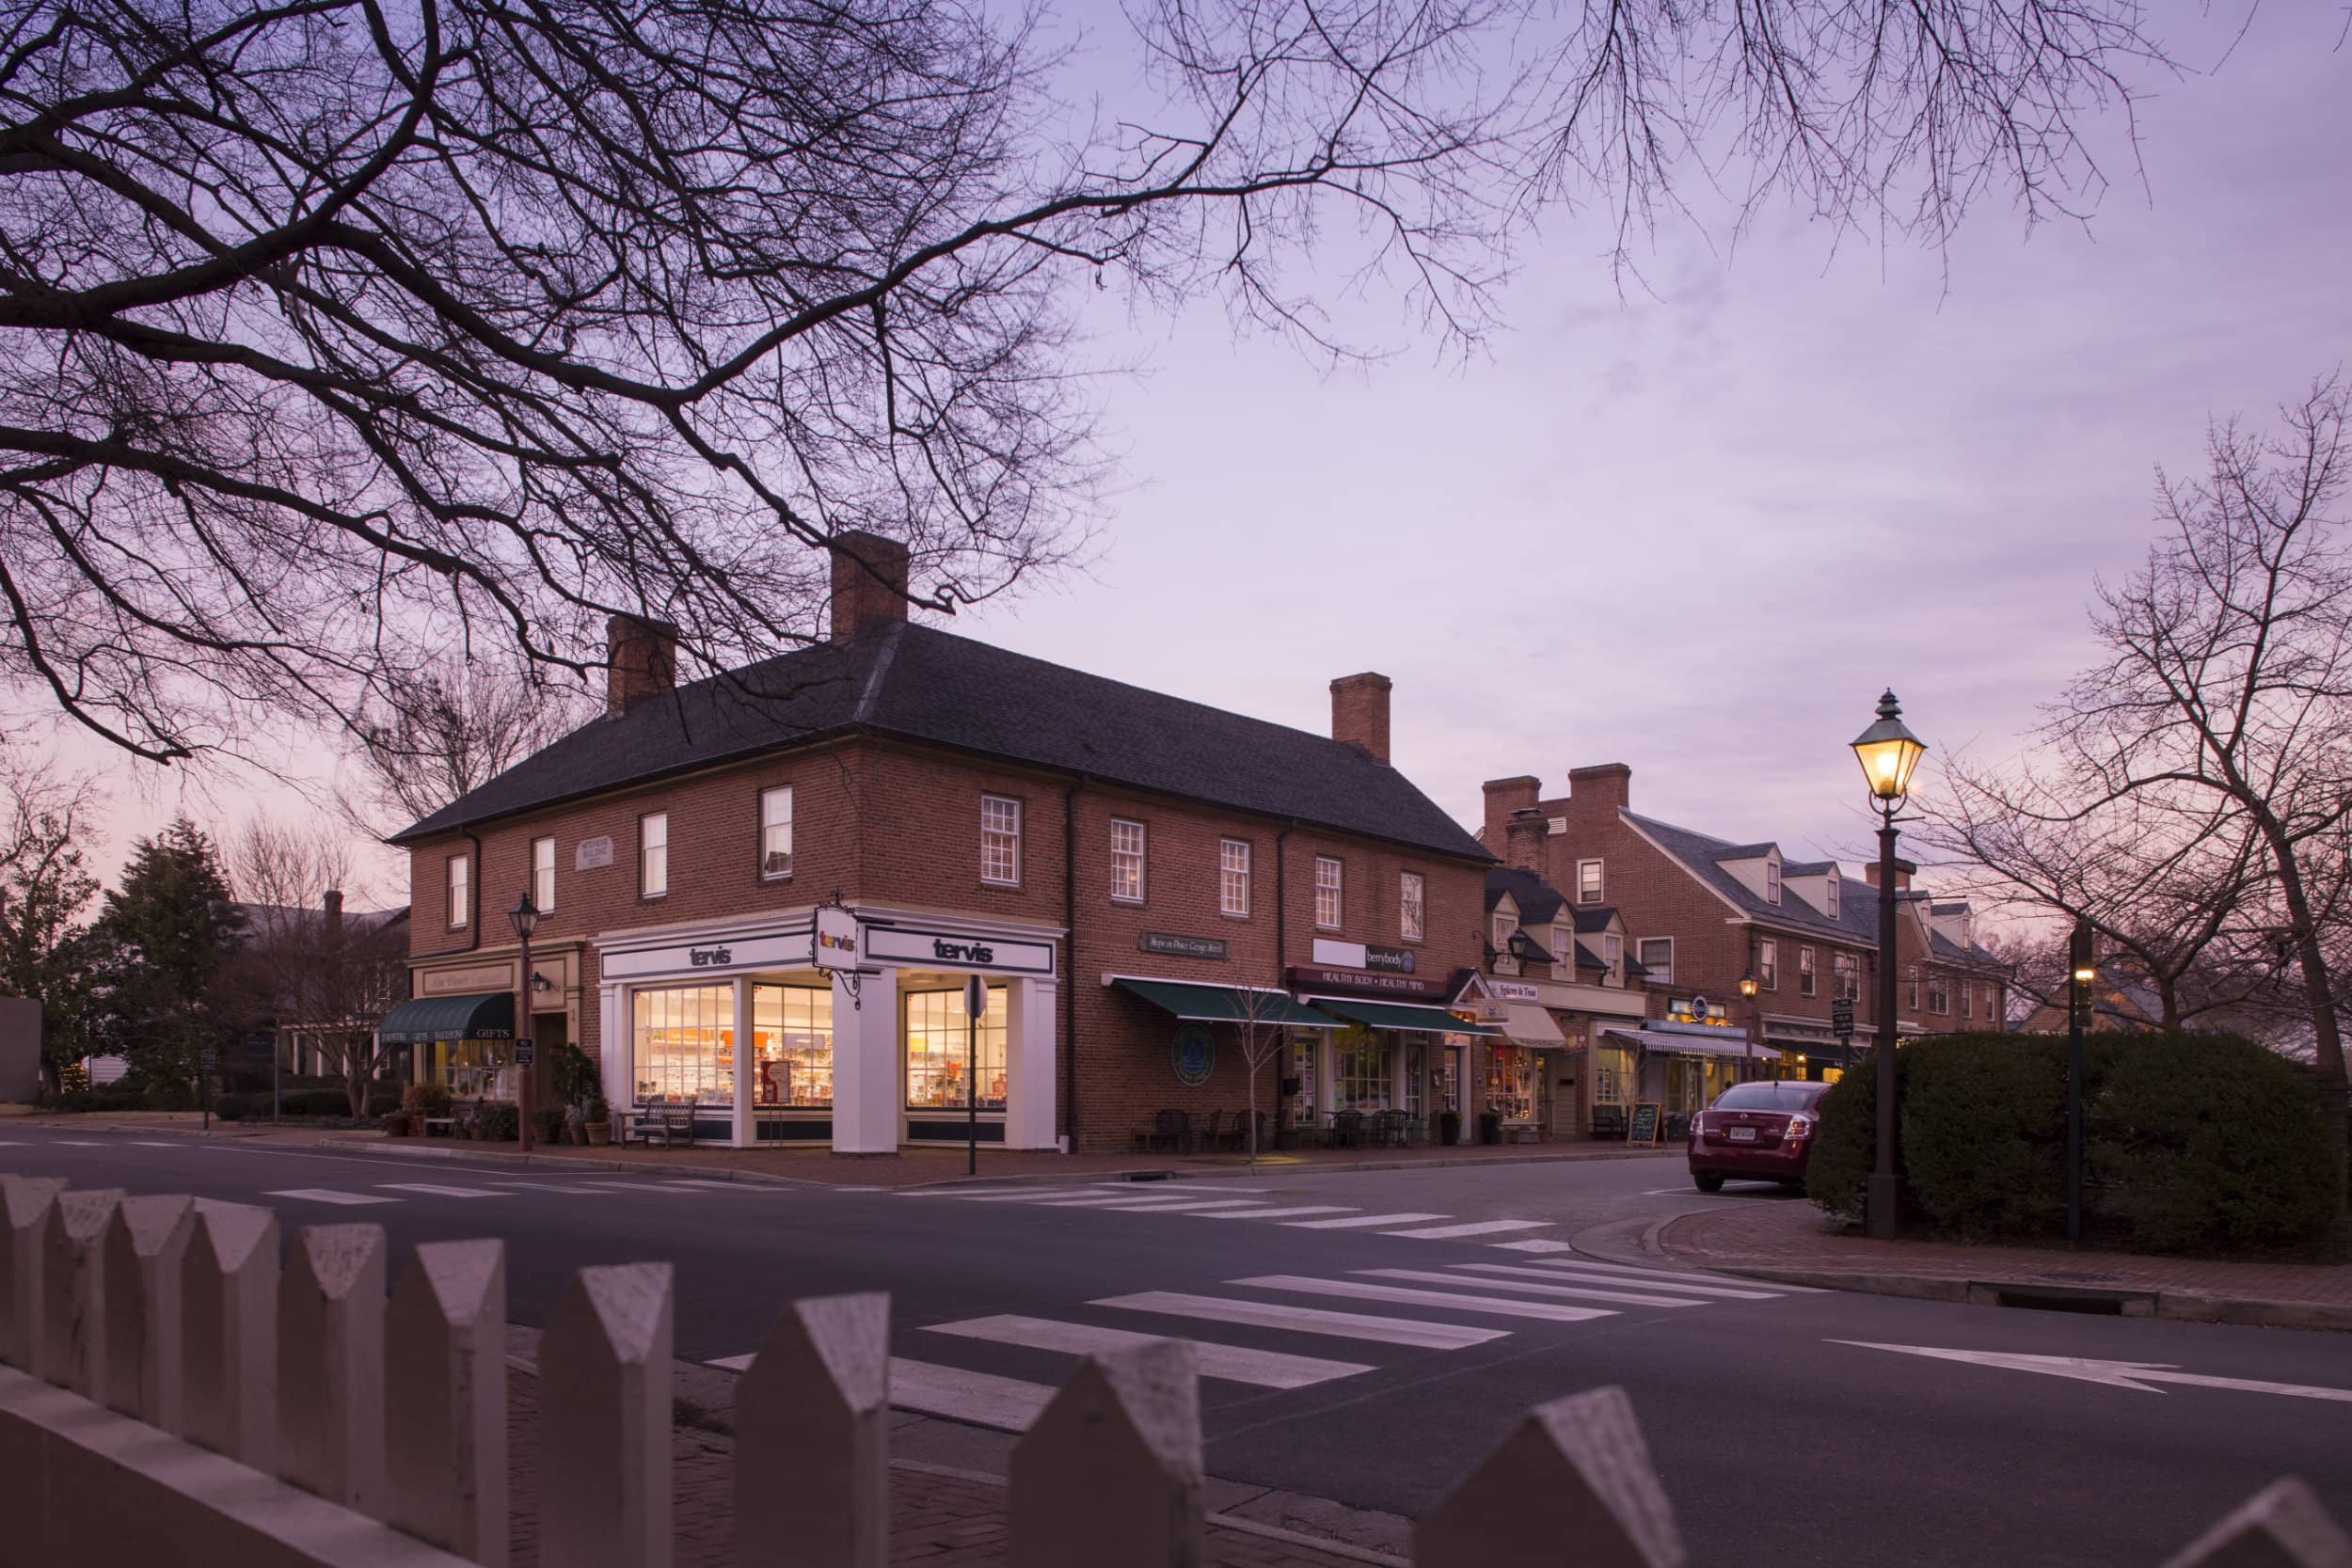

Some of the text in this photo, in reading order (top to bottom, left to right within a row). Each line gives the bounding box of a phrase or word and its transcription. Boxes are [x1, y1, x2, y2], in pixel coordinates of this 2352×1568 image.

[819, 930, 855, 952] tervis
[933, 939, 993, 963] tervis
[690, 945, 732, 966] tervis
[1366, 946, 1401, 967] berrybody
[1323, 971, 1424, 991] HEALTHY BODY HEALTHY MIND
[476, 1027, 511, 1039] GIFTS
